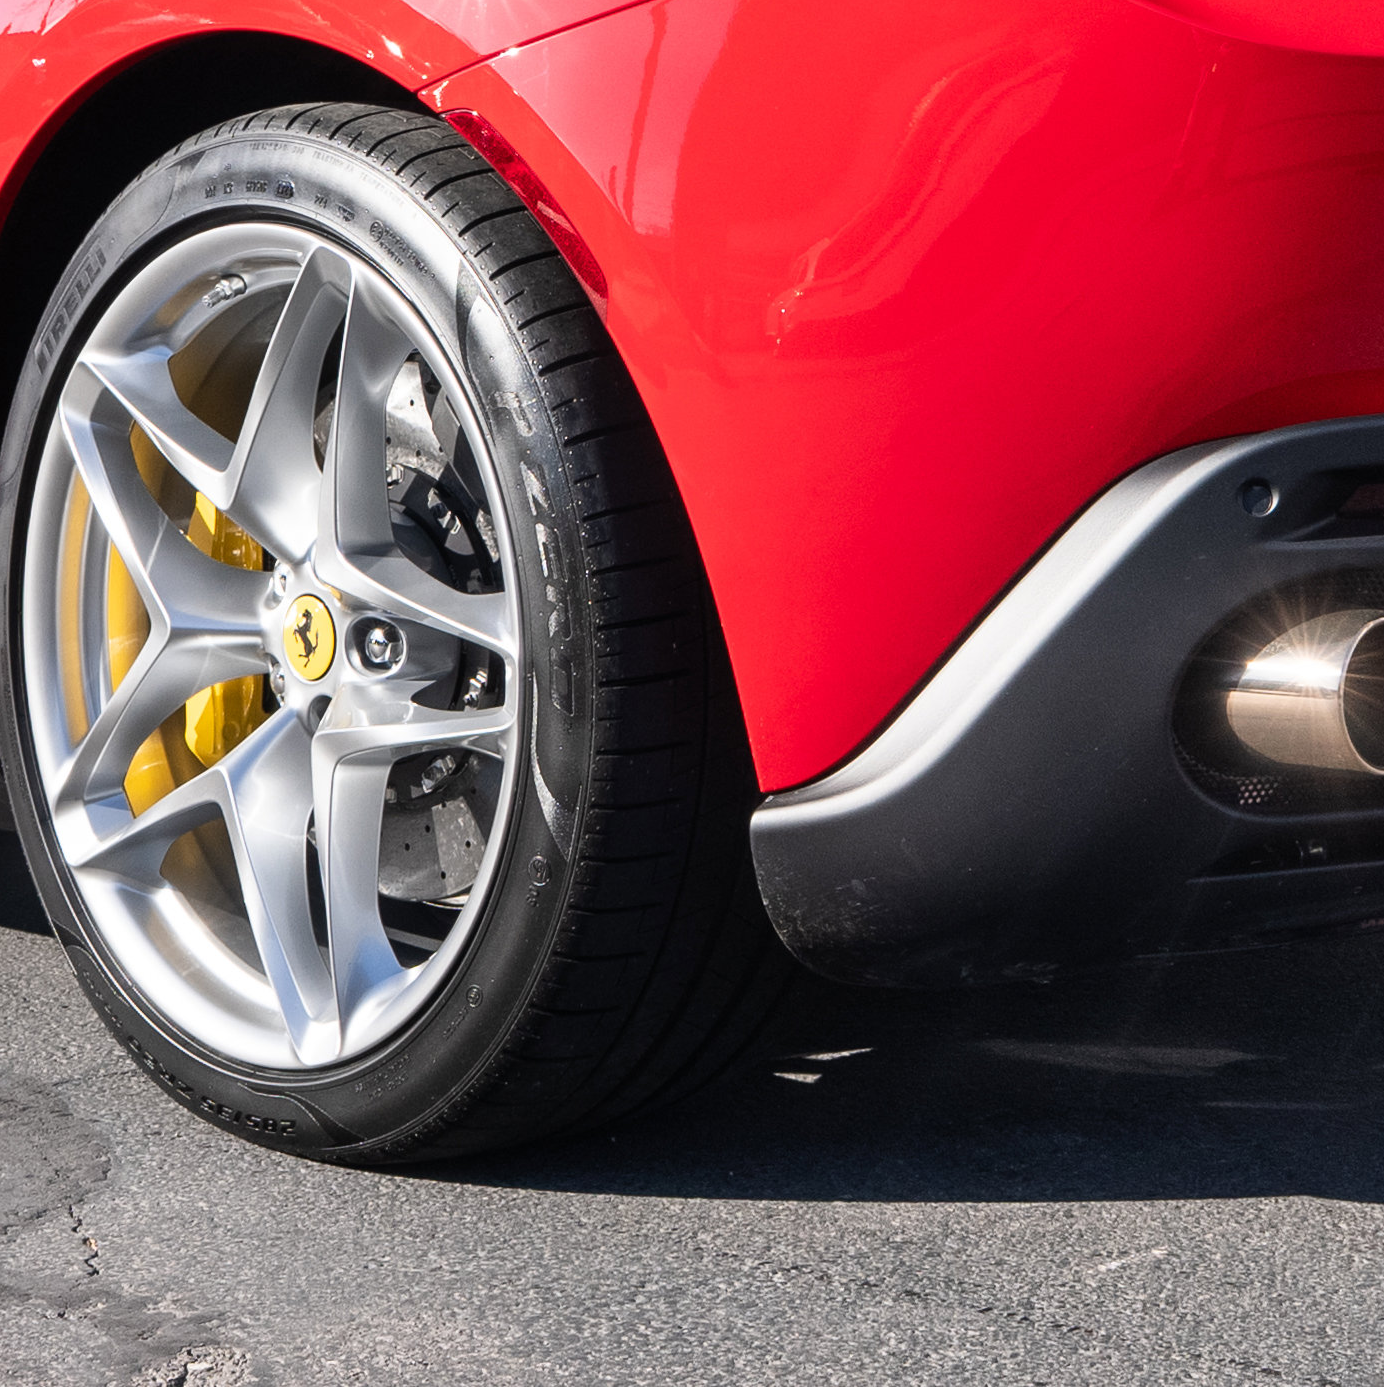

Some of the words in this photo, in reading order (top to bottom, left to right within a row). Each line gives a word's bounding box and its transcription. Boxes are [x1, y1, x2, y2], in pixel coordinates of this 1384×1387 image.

[34, 246, 107, 375] PIRELLI
[488, 390, 534, 437] P
[199, 1095, 297, 1137] 285/35
